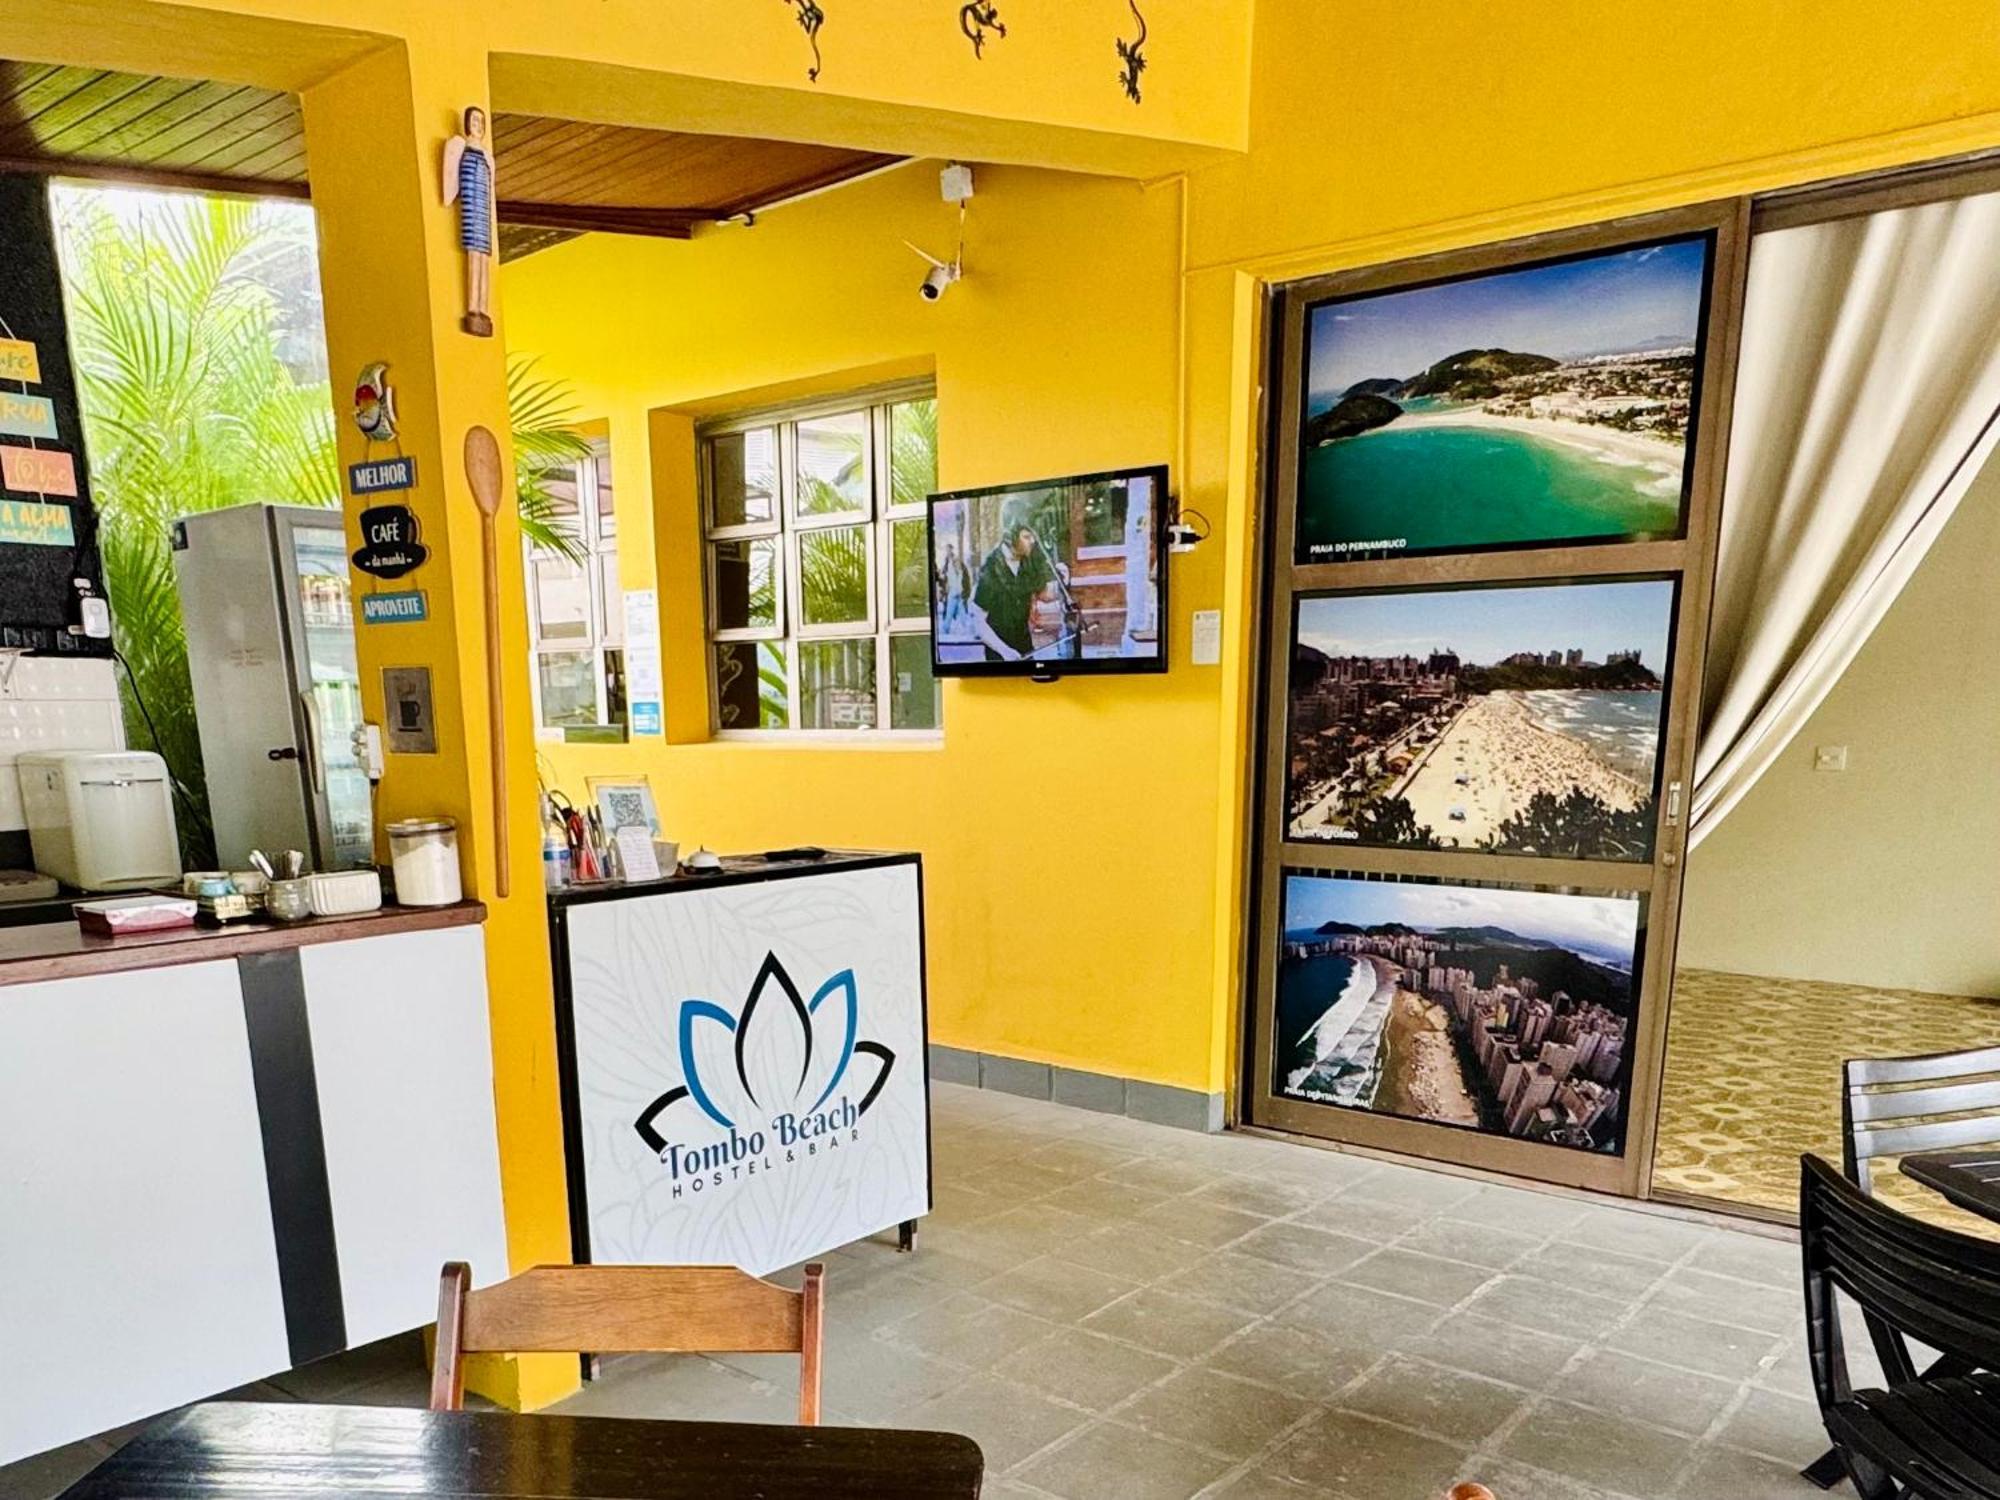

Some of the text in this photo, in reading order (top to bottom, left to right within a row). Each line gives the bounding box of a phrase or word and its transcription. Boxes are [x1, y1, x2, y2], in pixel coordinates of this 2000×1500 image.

[356, 463, 407, 489] MELHOR
[371, 517, 400, 544] CAFÉ
[372, 554, 381, 567] da
[1310, 544, 1333, 554] PRAIA
[1335, 542, 1347, 552] DO
[364, 597, 421, 617] APROVEITE
[660, 1096, 858, 1180] Tombo Beach
[672, 1129, 860, 1199] HOSTEL & BAR
